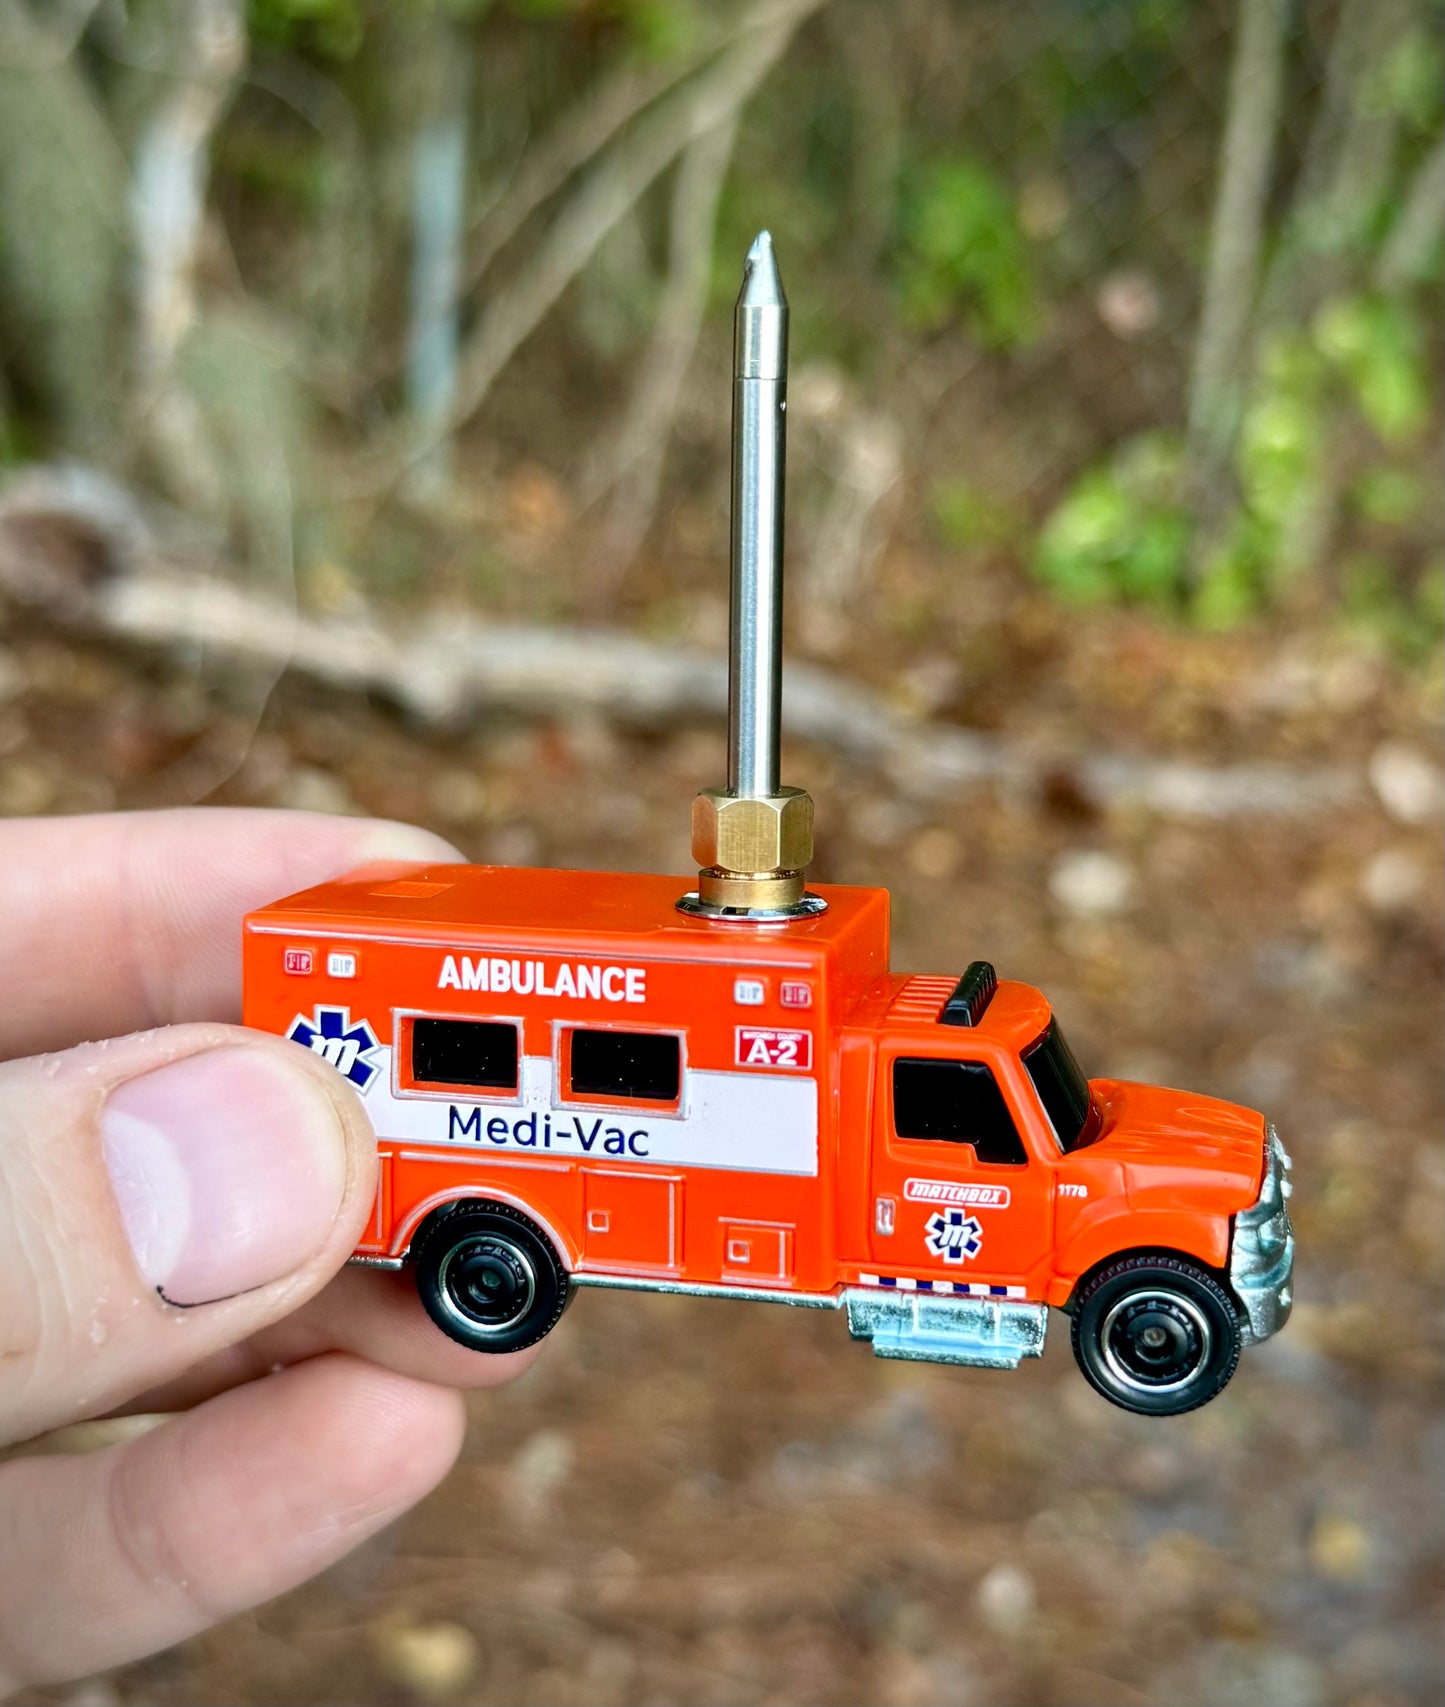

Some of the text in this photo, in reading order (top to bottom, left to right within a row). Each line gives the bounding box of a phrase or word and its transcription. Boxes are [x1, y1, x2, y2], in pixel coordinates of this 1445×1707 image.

[437, 955, 646, 1003] AMBULANCE
[746, 1037, 798, 1066] A-2
[448, 1104, 650, 1157] Medi-Vac
[910, 1182, 1002, 1204] MATCHBOX
